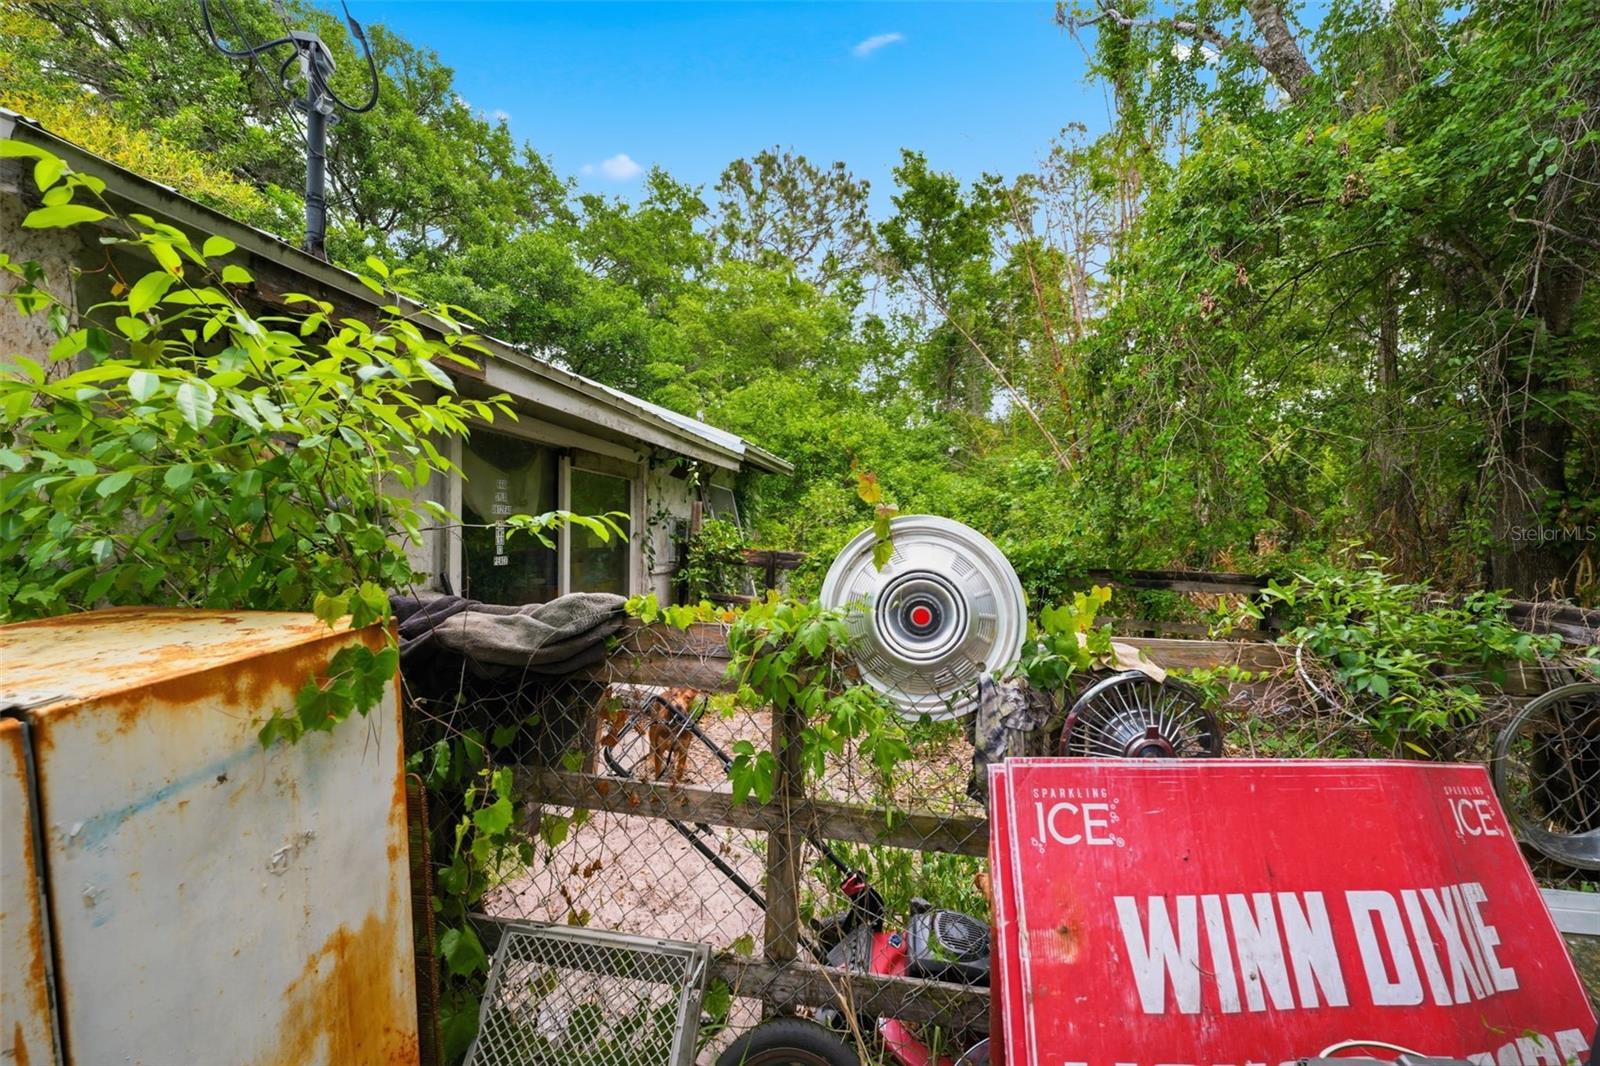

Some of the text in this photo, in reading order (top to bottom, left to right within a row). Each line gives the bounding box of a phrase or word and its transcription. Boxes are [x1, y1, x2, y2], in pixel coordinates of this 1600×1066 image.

[1033, 788, 1108, 798] SPARKLING
[1034, 801, 1115, 845] ICE
[1448, 798, 1500, 836] ICE
[1113, 882, 1519, 1015] WINN DIXIE
